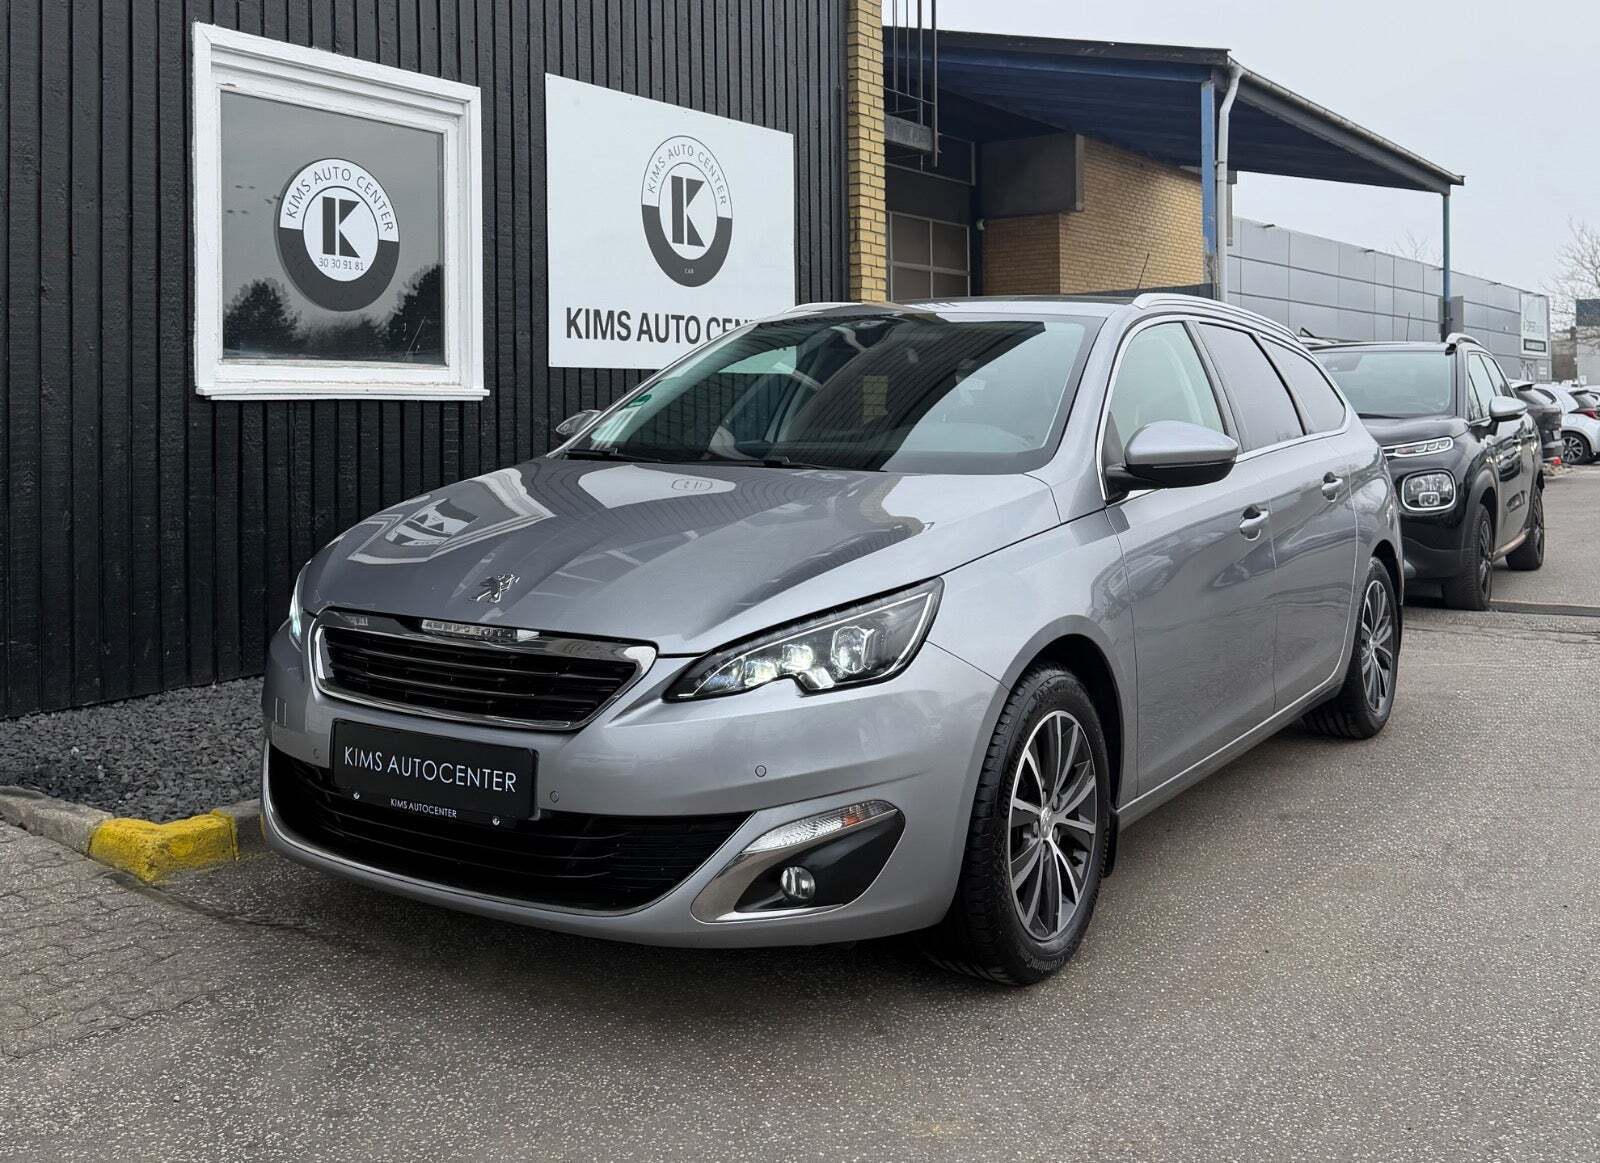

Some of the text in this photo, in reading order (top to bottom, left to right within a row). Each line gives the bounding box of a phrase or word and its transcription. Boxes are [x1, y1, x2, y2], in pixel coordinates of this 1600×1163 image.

[647, 144, 727, 205] KIMS AUTO CENTER
[285, 166, 394, 232] KIMS AUTO CENTER
[319, 257, 364, 271] 30 30 91 81
[565, 306, 632, 342] KIMS
[636, 311, 701, 345] AUTO
[344, 746, 517, 793] KIMS AUTOCENTER
[390, 798, 457, 819] KIMS AUTOCENTER
